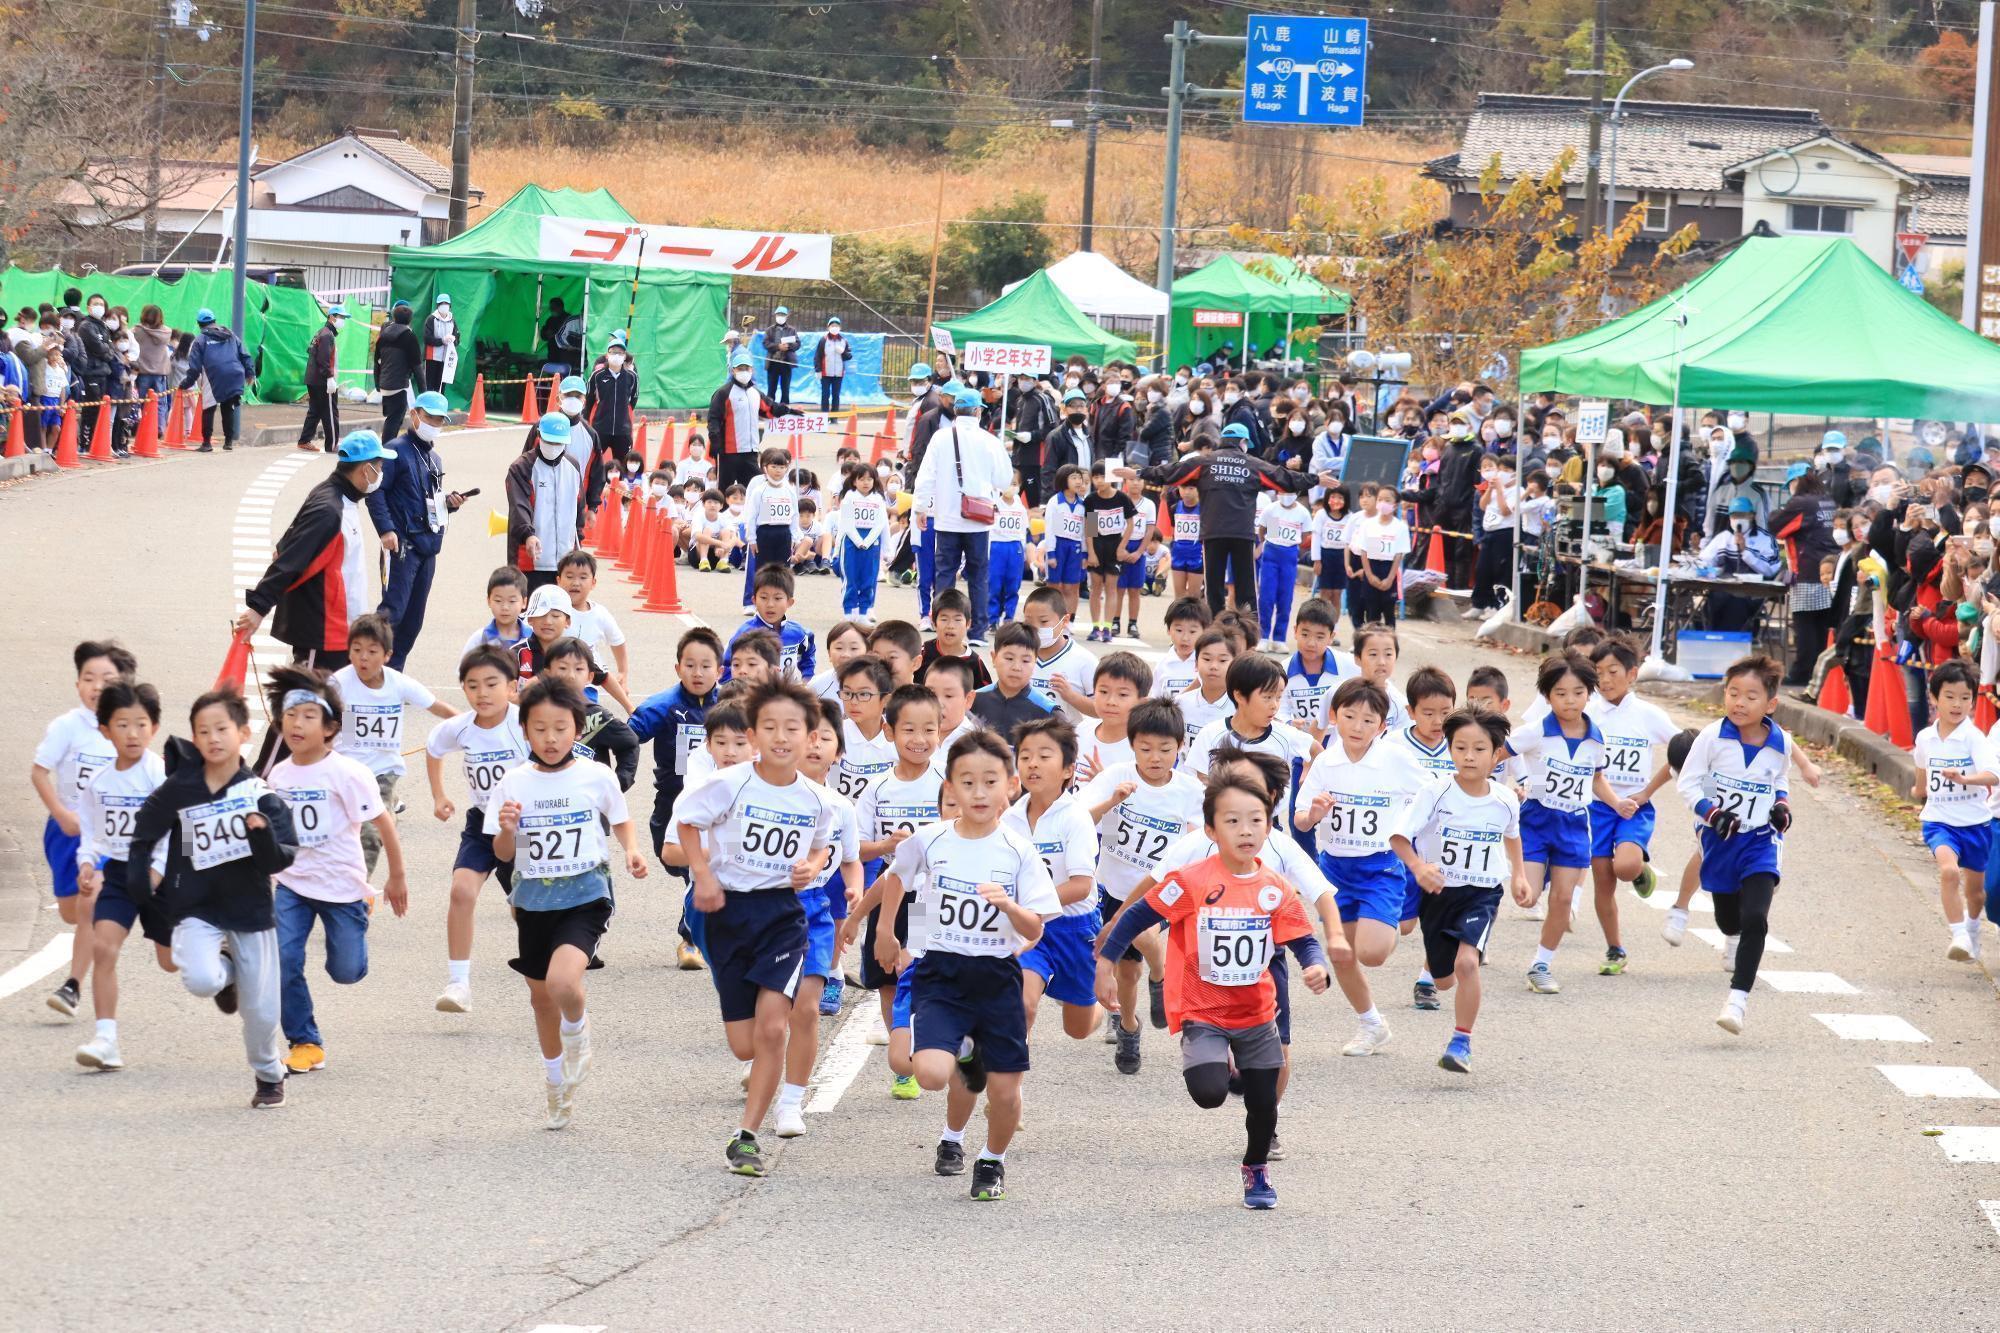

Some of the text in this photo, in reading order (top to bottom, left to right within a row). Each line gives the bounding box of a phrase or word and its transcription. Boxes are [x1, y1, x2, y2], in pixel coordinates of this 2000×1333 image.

[1254, 25, 1291, 41] 八鹿
[1261, 43, 1281, 52] Yoka
[1322, 45, 1361, 54] Yamasaki
[1276, 61, 1291, 73] 429
[1320, 62, 1335, 75] 429
[1251, 83, 1287, 99] 朝来
[1321, 86, 1358, 102] 波賀
[1256, 101, 1281, 111] Asago
[1328, 103, 1349, 113] Haga
[570, 226, 798, 271] ゴール
[970, 346, 1046, 368] 小学2年女子
[768, 417, 825, 433] 小学3年女子
[1216, 456, 1246, 464] HYOGO
[1210, 464, 1250, 478] SHISO
[1214, 475, 1245, 483] SPORTS
[1000, 516, 1021, 529] 606
[1099, 515, 1120, 529] 604
[1176, 520, 1198, 533] 603
[356, 717, 399, 738] 547
[837, 773, 868, 799] 52
[1546, 771, 1584, 801] 524
[534, 798, 570, 810] FAVORABLE
[877, 807, 939, 817] 宍粟市ロードレー
[105, 810, 136, 836] 52
[1331, 806, 1378, 836] 513
[194, 813, 247, 851] 540
[527, 828, 582, 860] 527
[743, 823, 800, 858] 506
[1117, 820, 1168, 862] 512
[1441, 841, 1491, 871] 511
[747, 858, 794, 873] 西兵庫信用金
[939, 894, 1000, 932] 502
[1212, 919, 1271, 931] 宍粟市ロードレ
[1213, 935, 1267, 967] 501
